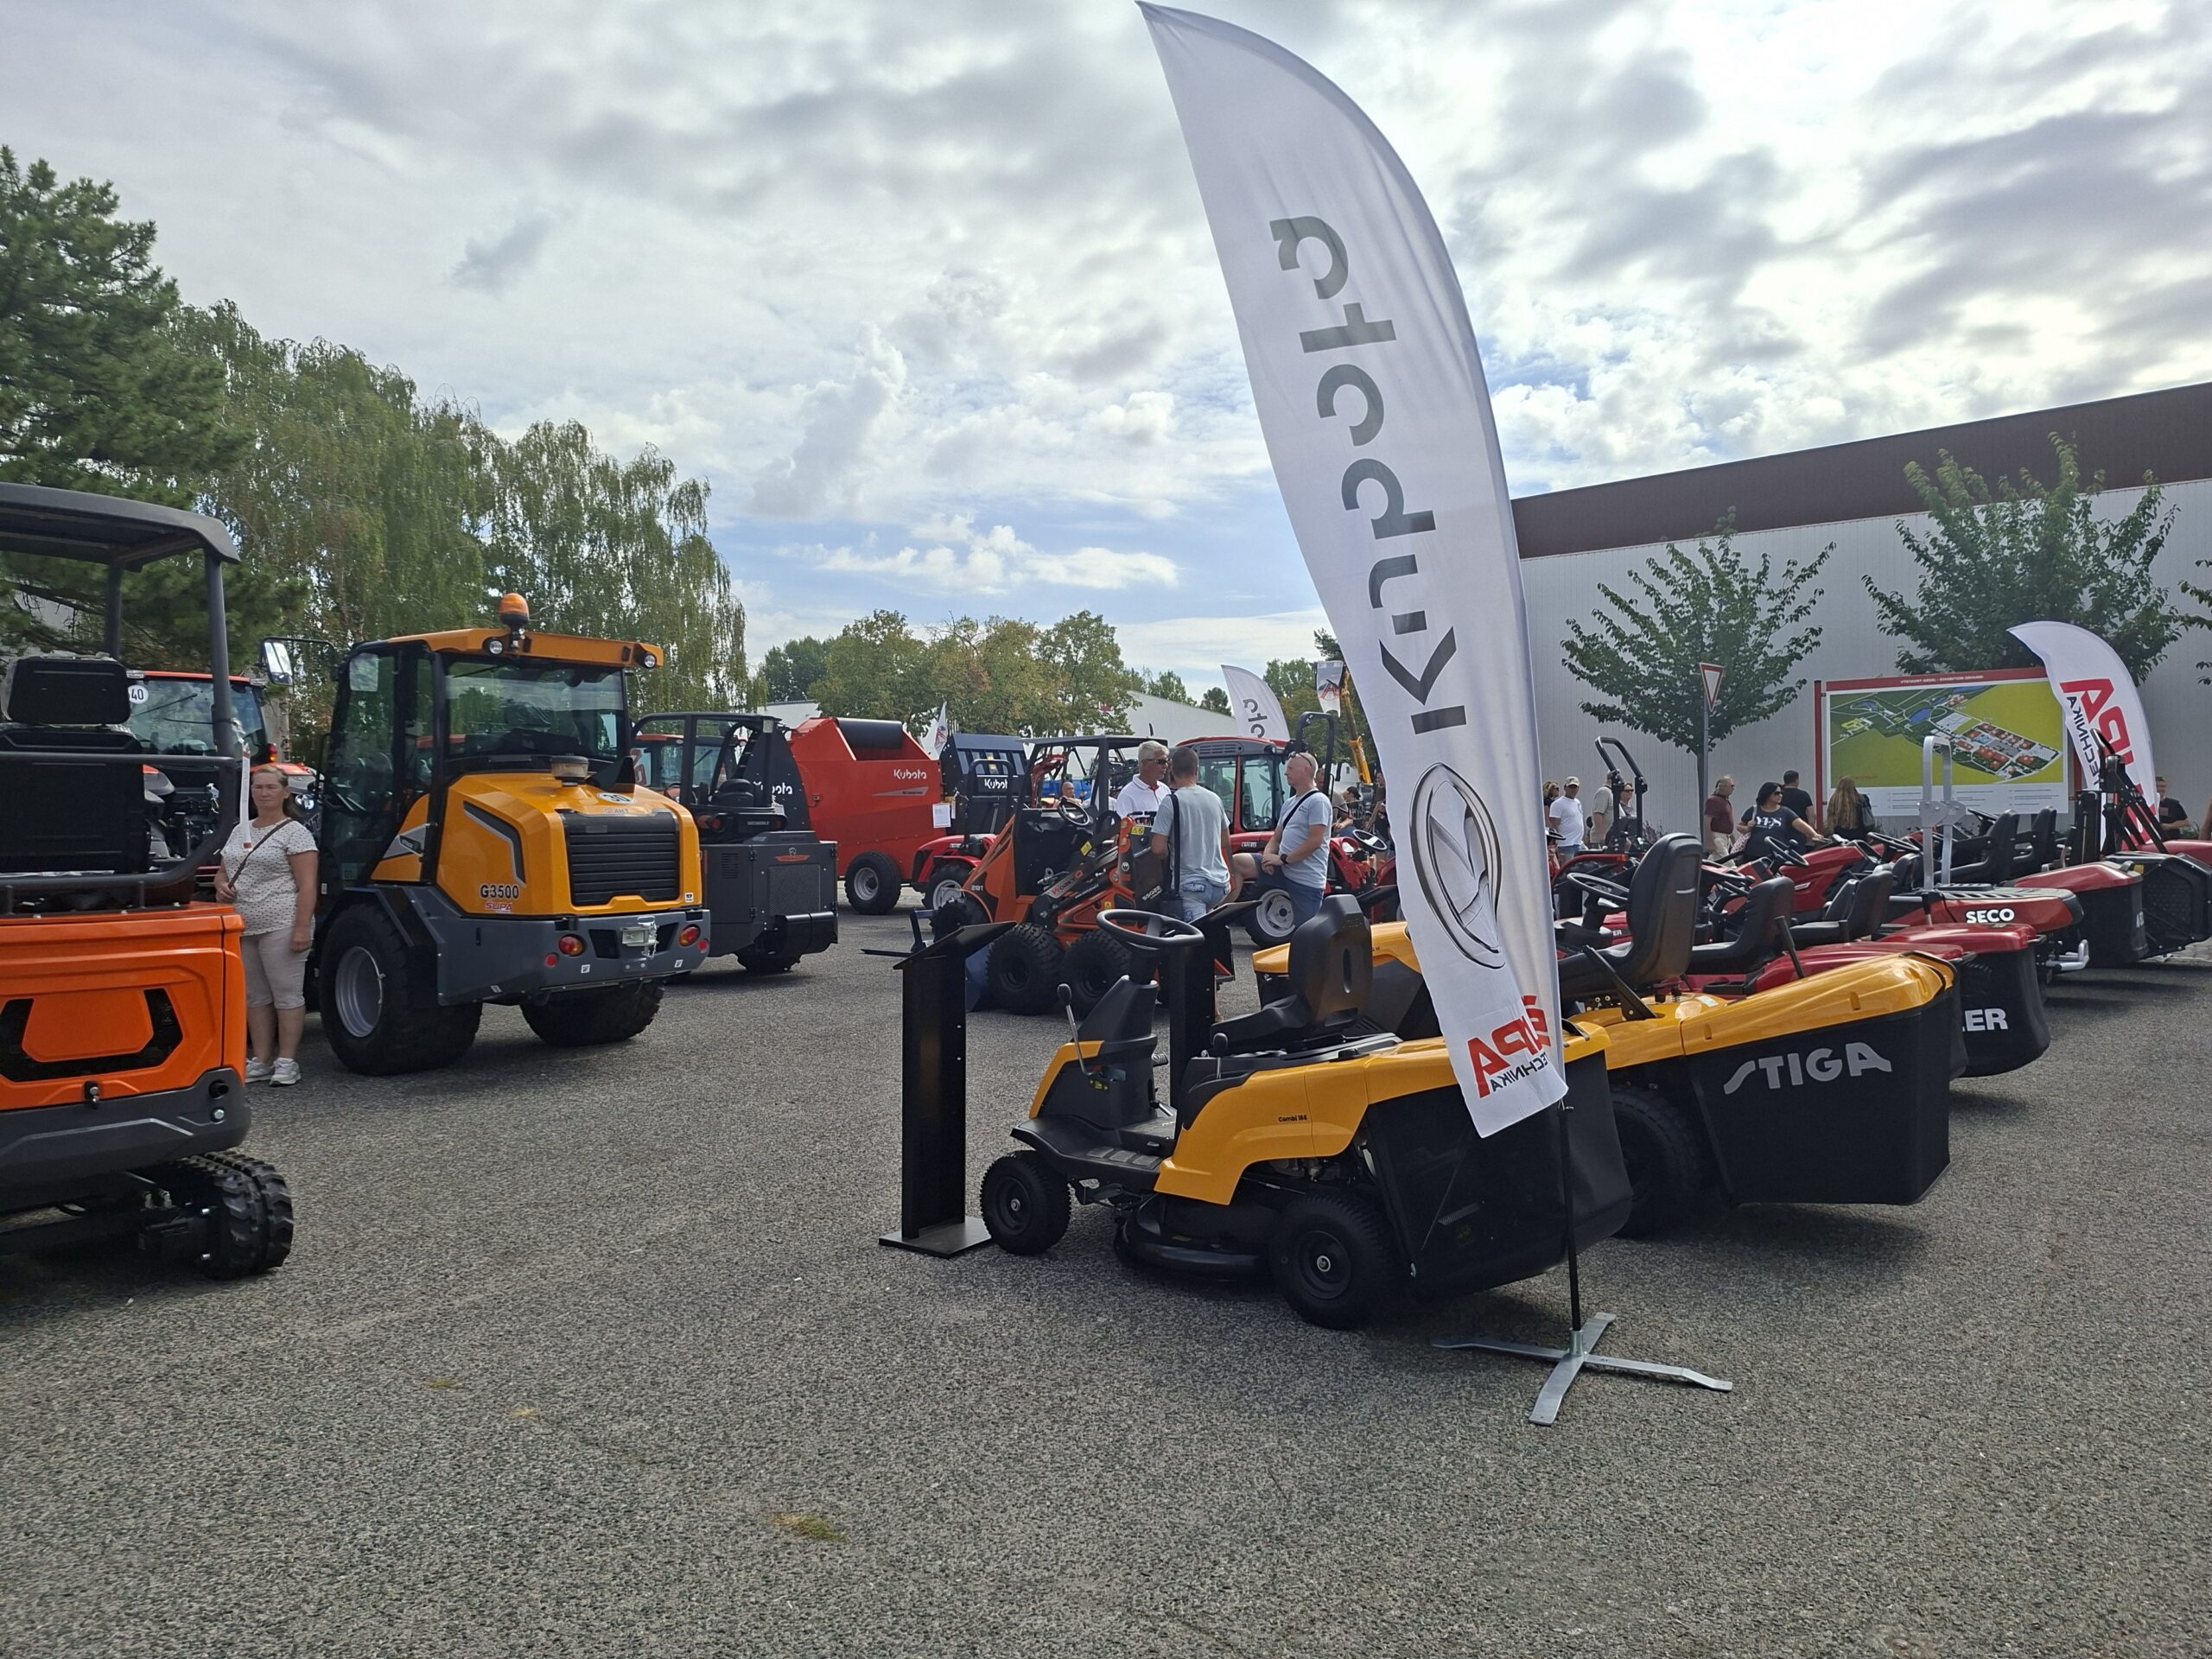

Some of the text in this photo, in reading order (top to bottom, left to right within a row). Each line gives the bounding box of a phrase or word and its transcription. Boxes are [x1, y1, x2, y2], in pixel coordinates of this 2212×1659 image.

[130, 689, 144, 701] 40
[893, 769, 927, 779] Kubota
[984, 779, 1008, 790] Kubot
[480, 884, 519, 899] G3500
[1966, 908, 2015, 924] SECO
[1962, 1008, 2009, 1032] ER
[1723, 1042, 1892, 1095] STIGA
